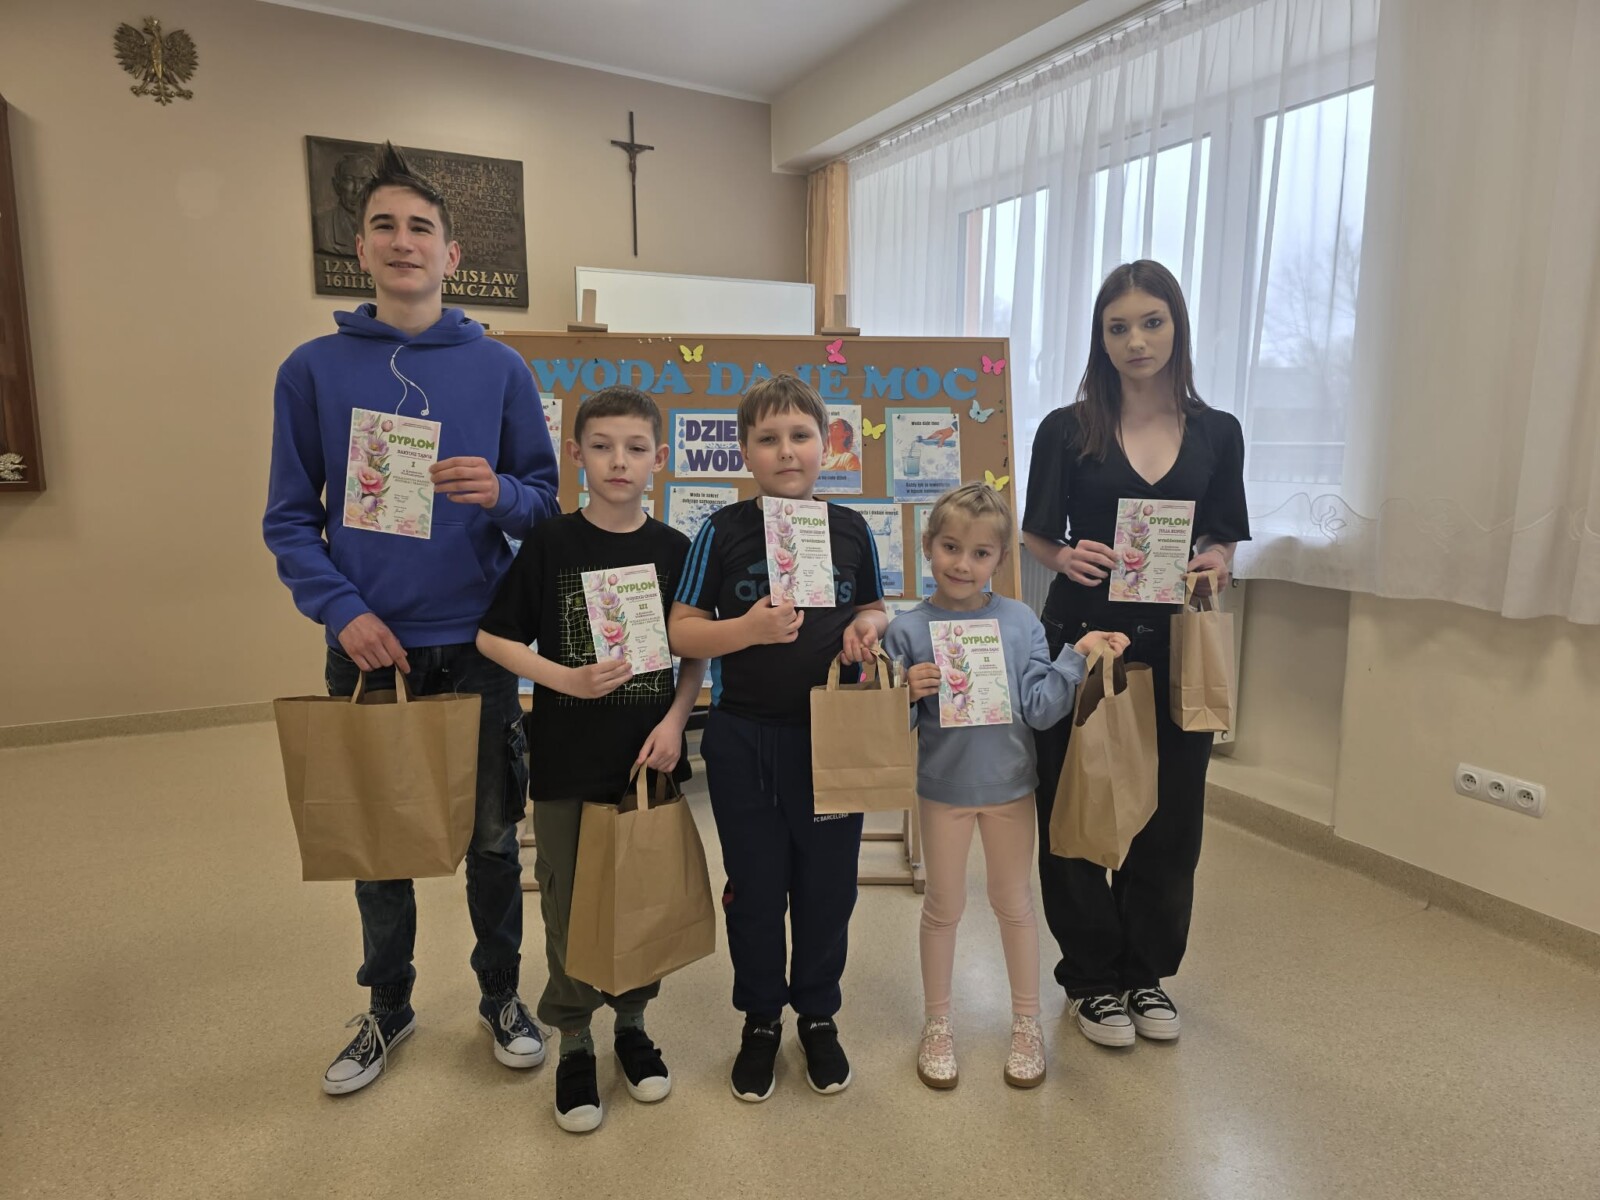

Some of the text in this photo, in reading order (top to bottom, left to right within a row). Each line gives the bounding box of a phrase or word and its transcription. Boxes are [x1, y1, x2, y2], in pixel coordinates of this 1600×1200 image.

[324, 260, 341, 272] 12
[359, 276, 375, 289] 19
[447, 270, 519, 285] NISŁAW
[442, 282, 519, 299] IMCZAK
[531, 359, 692, 393] WODA
[861, 364, 978, 400] MOC
[685, 420, 738, 442] DZIE
[388, 434, 435, 449] DYPLOM
[685, 449, 744, 472] WOD
[791, 516, 826, 527] DYPLOM
[1149, 517, 1190, 527] DYPLOM
[617, 582, 655, 593] DYPLOM
[961, 635, 999, 645] DYPLOM
